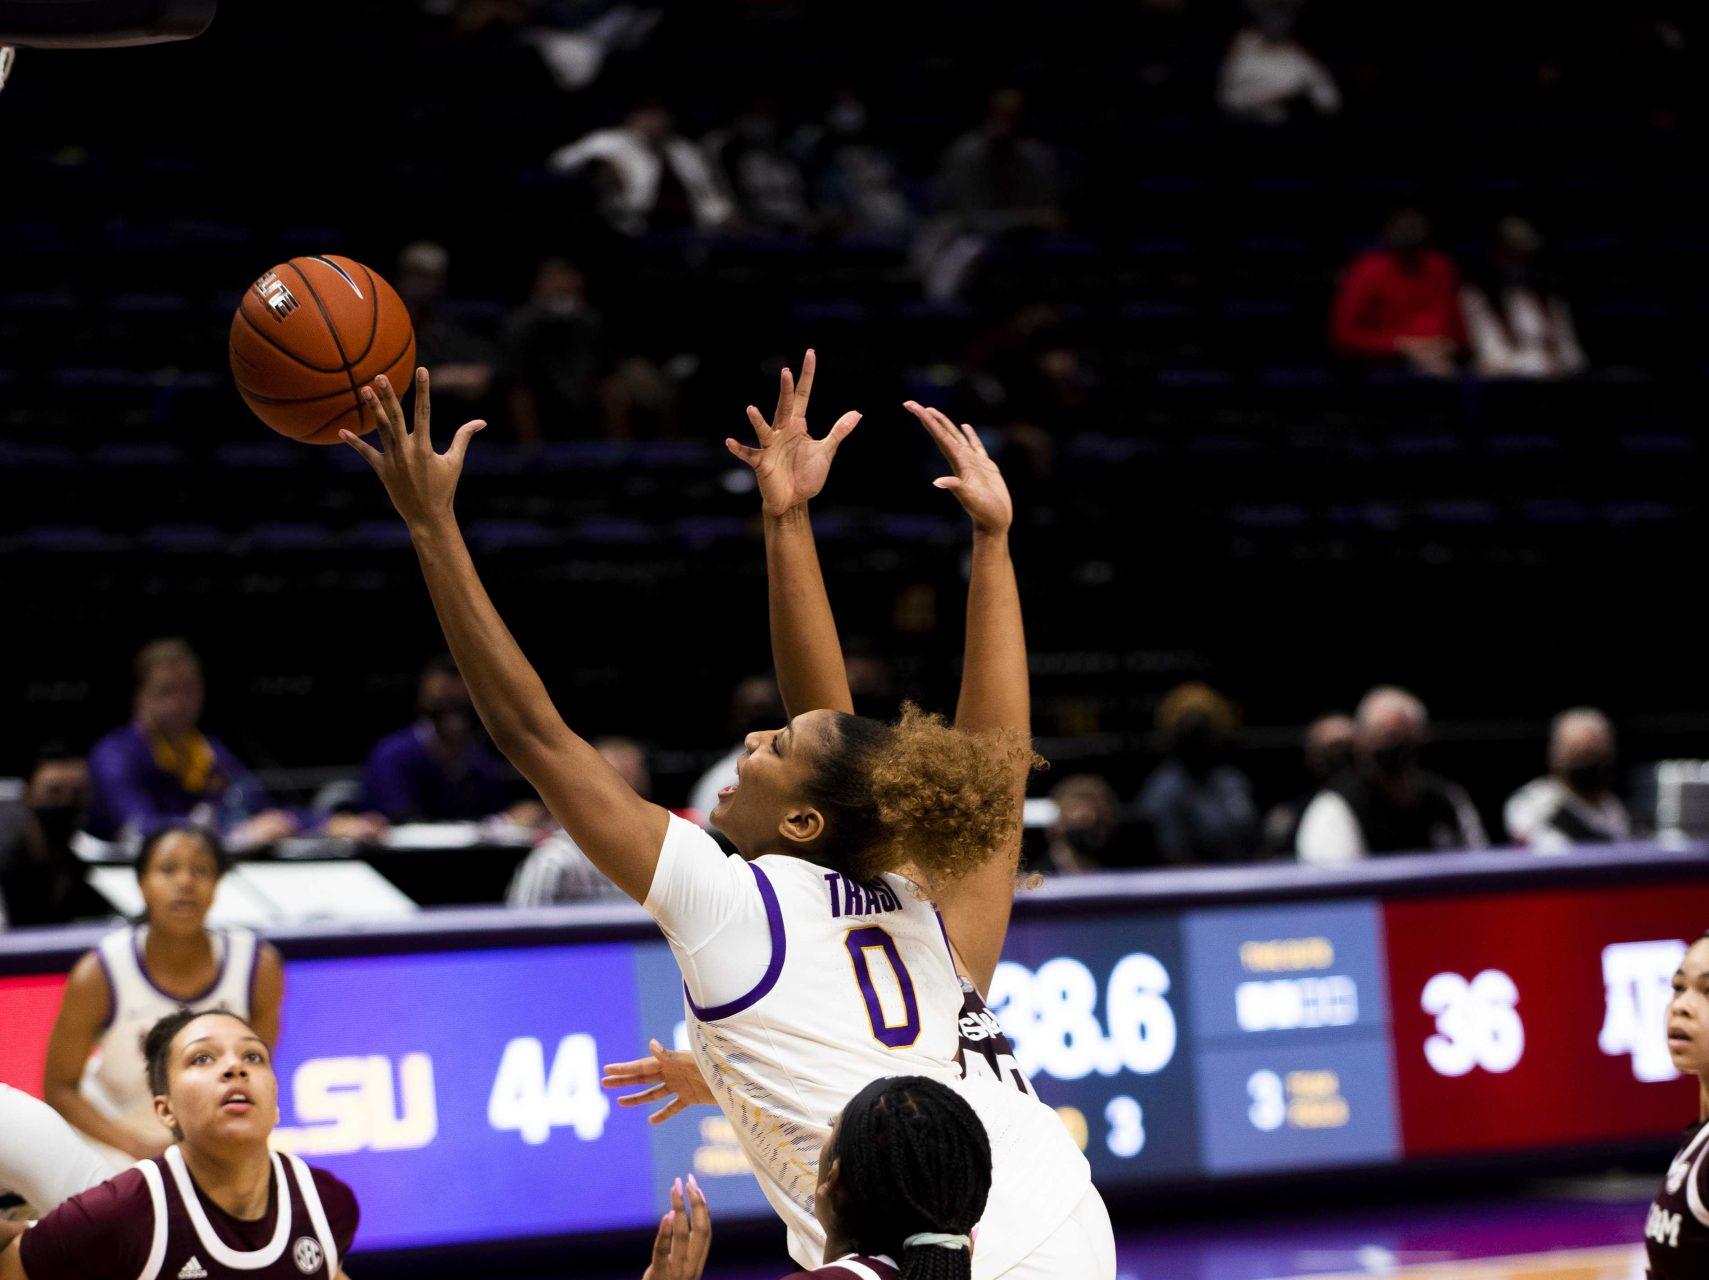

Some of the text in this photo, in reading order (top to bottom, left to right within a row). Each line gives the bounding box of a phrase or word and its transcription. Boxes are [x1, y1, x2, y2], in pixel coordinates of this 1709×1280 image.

[845, 925, 922, 1049] 0
[1420, 968, 1525, 1077] 36
[487, 1033, 610, 1145] 44
[1104, 1095, 1146, 1158] 3
